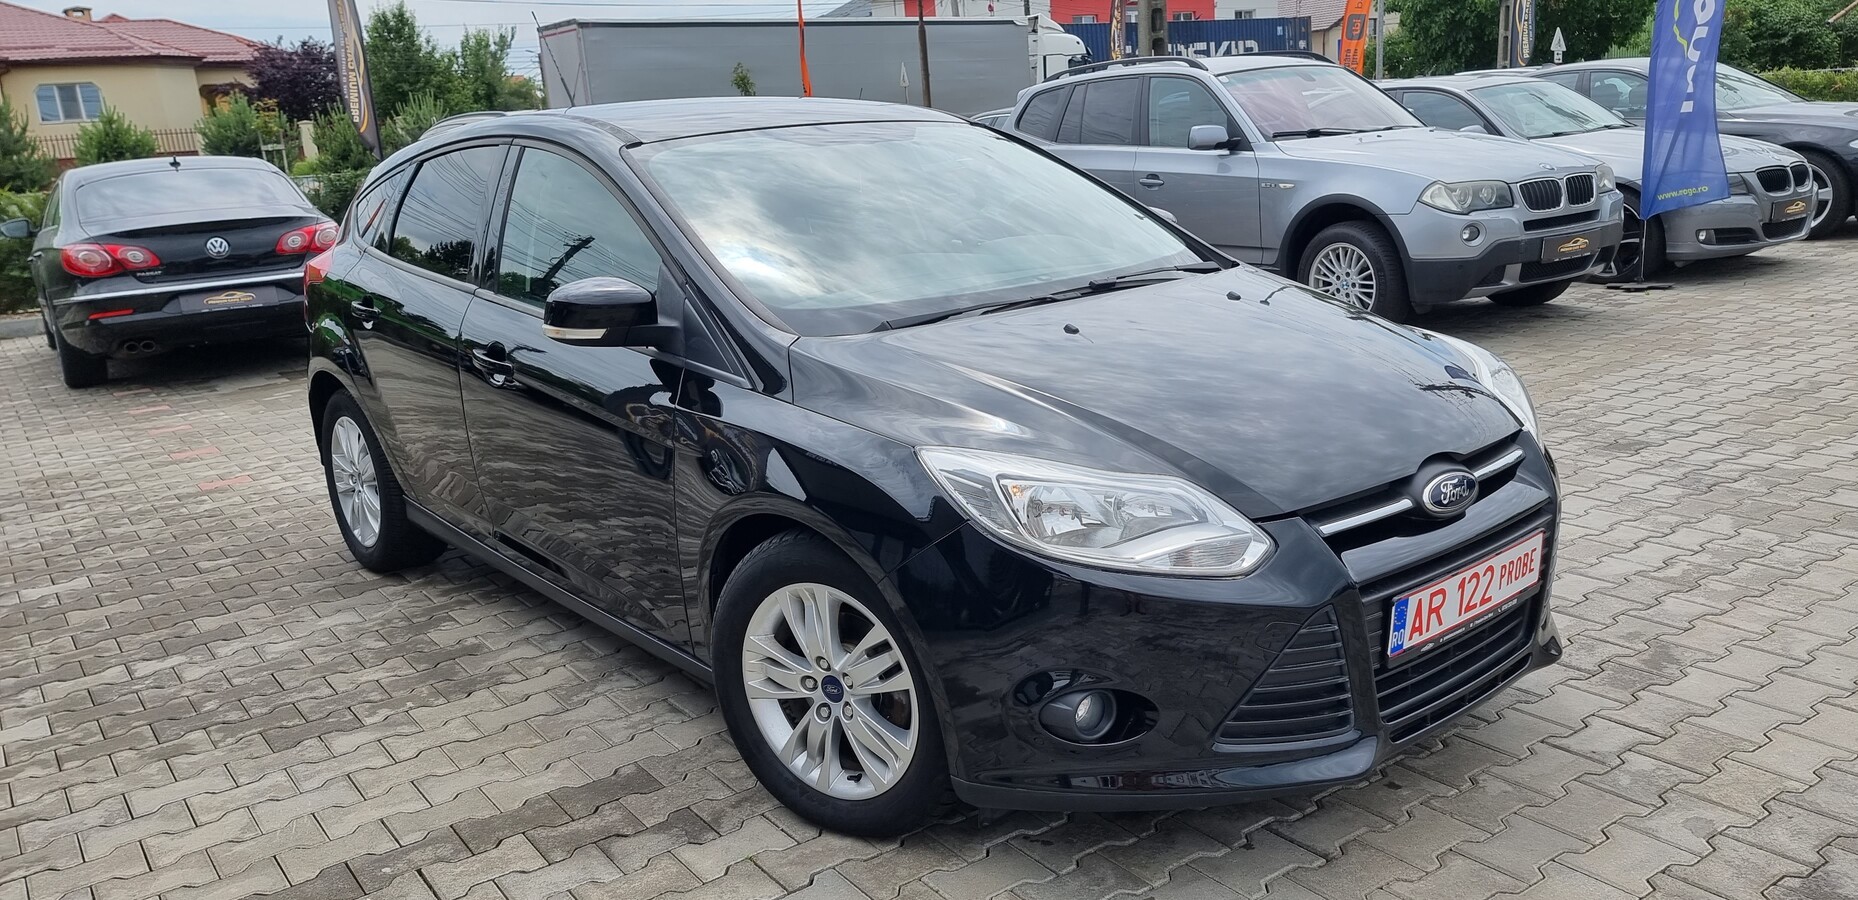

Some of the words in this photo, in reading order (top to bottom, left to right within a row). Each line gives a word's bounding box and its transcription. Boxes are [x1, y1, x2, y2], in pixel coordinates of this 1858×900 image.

[1352, 18, 1361, 36] tbi
[1440, 478, 1470, 504] Ford
[1408, 587, 1447, 642] AR
[1457, 564, 1495, 618] 122
[1498, 547, 1537, 590] PROBE
[1391, 629, 1404, 649] RO
